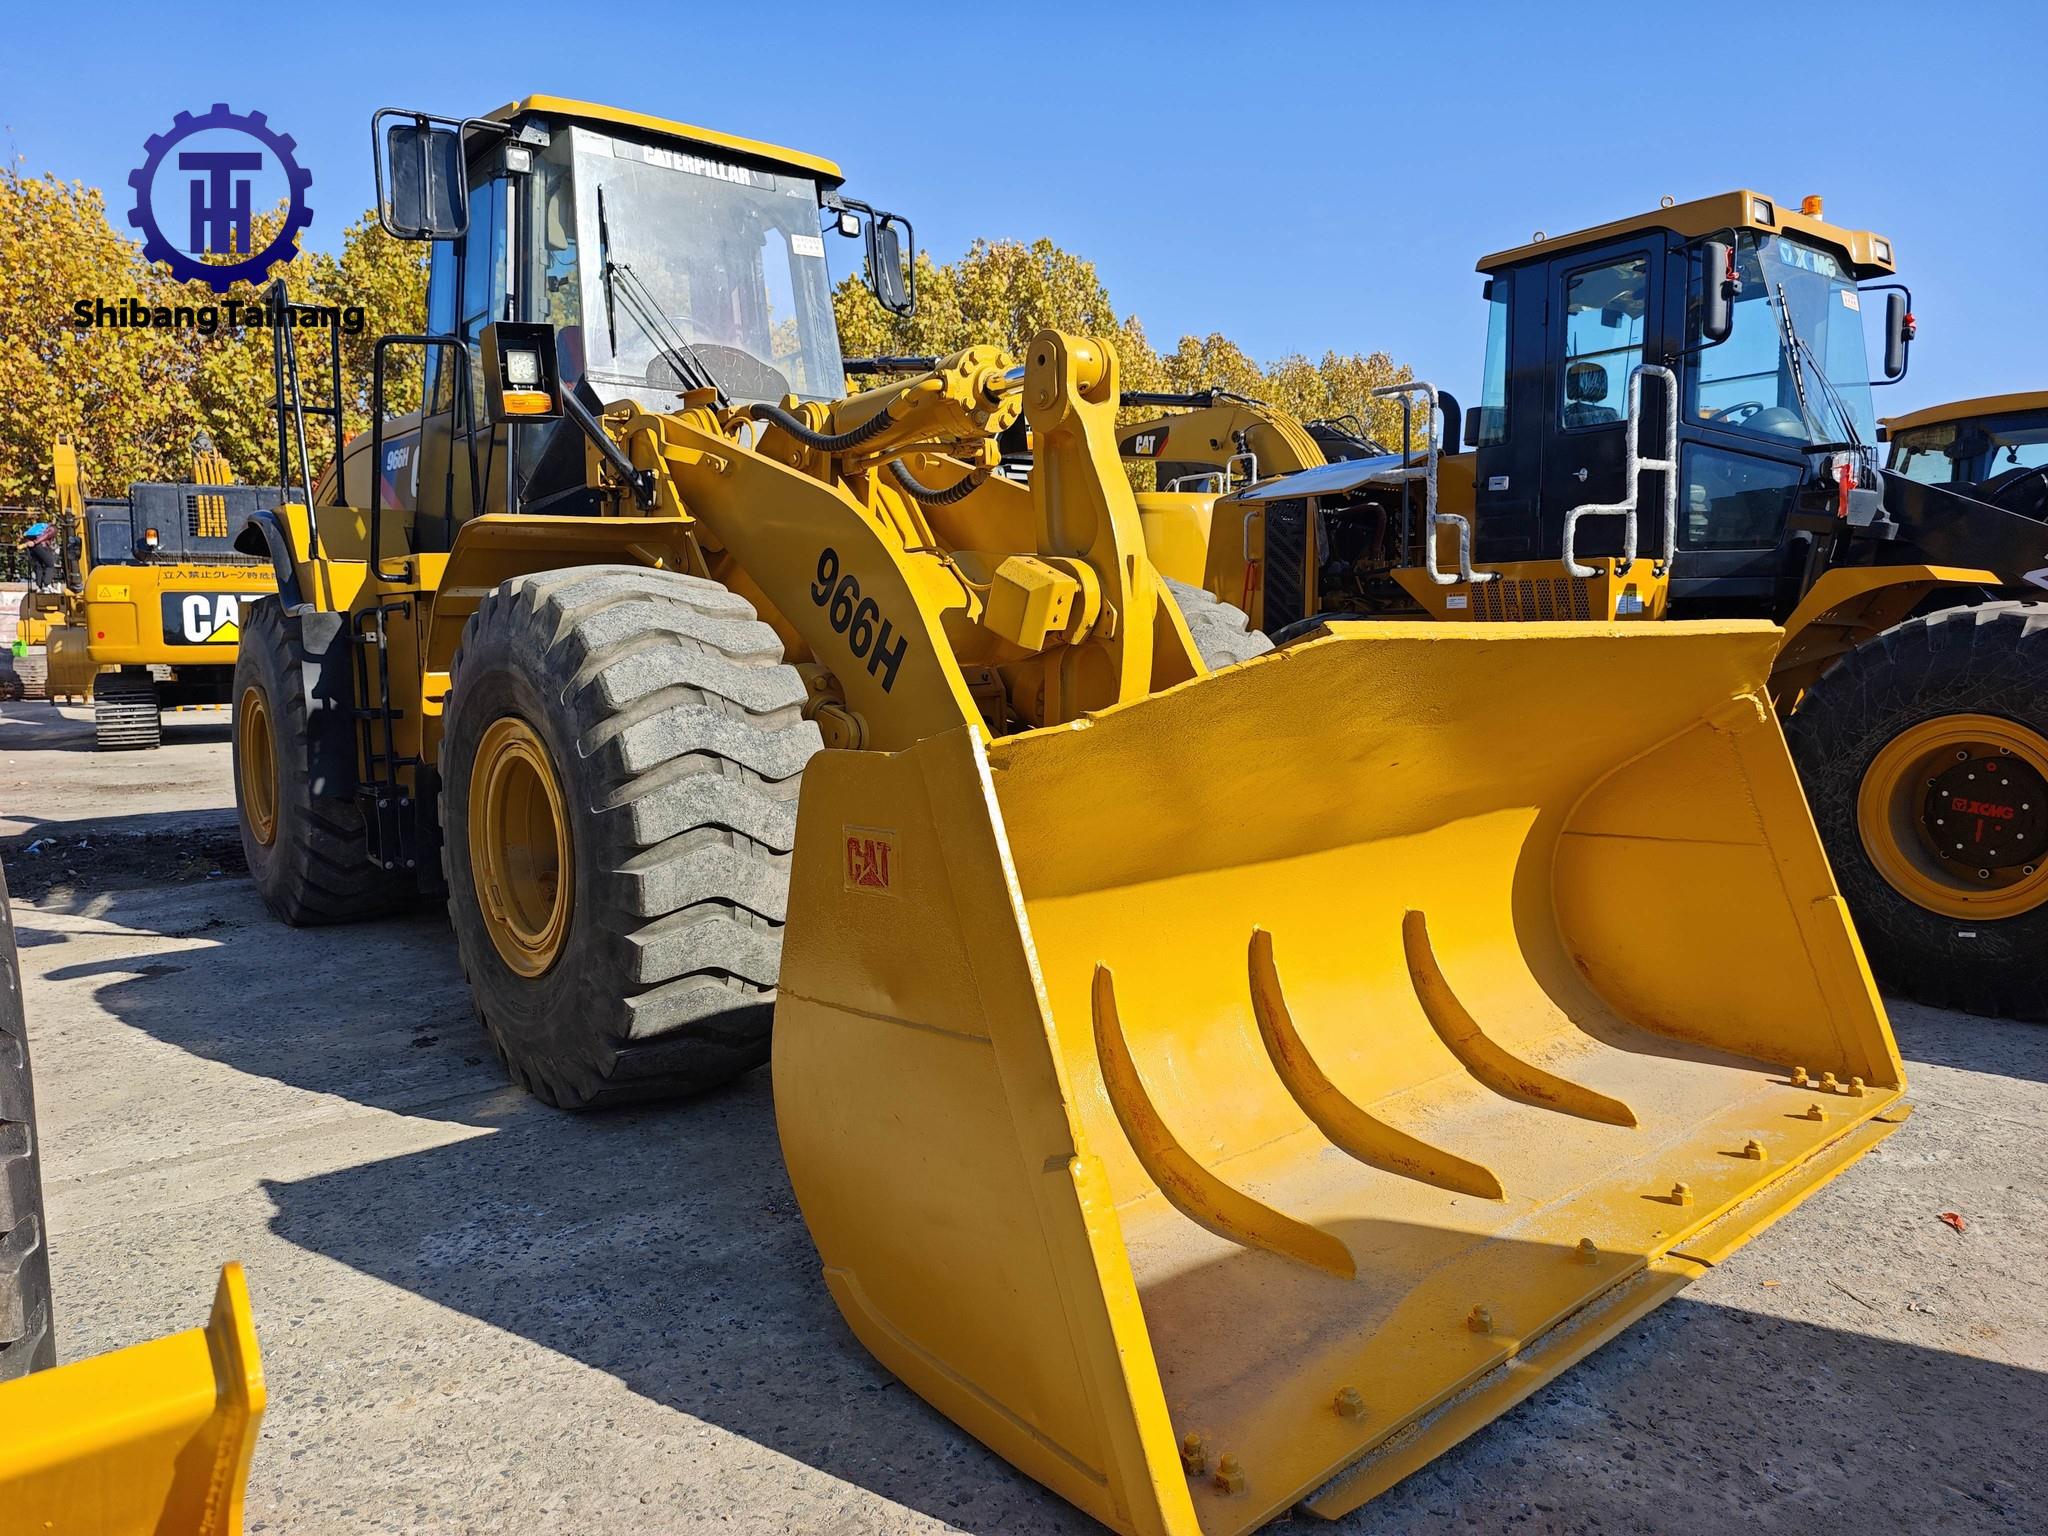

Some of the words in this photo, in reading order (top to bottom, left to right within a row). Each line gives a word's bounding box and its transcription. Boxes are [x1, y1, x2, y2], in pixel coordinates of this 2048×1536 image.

[642, 145, 751, 186] CATERPILLAR
[386, 446, 410, 471] 966H
[1135, 435, 1156, 454] CAT
[811, 547, 908, 694] 966H
[1967, 800, 2015, 820] XCMG
[847, 836, 891, 888] CAT
